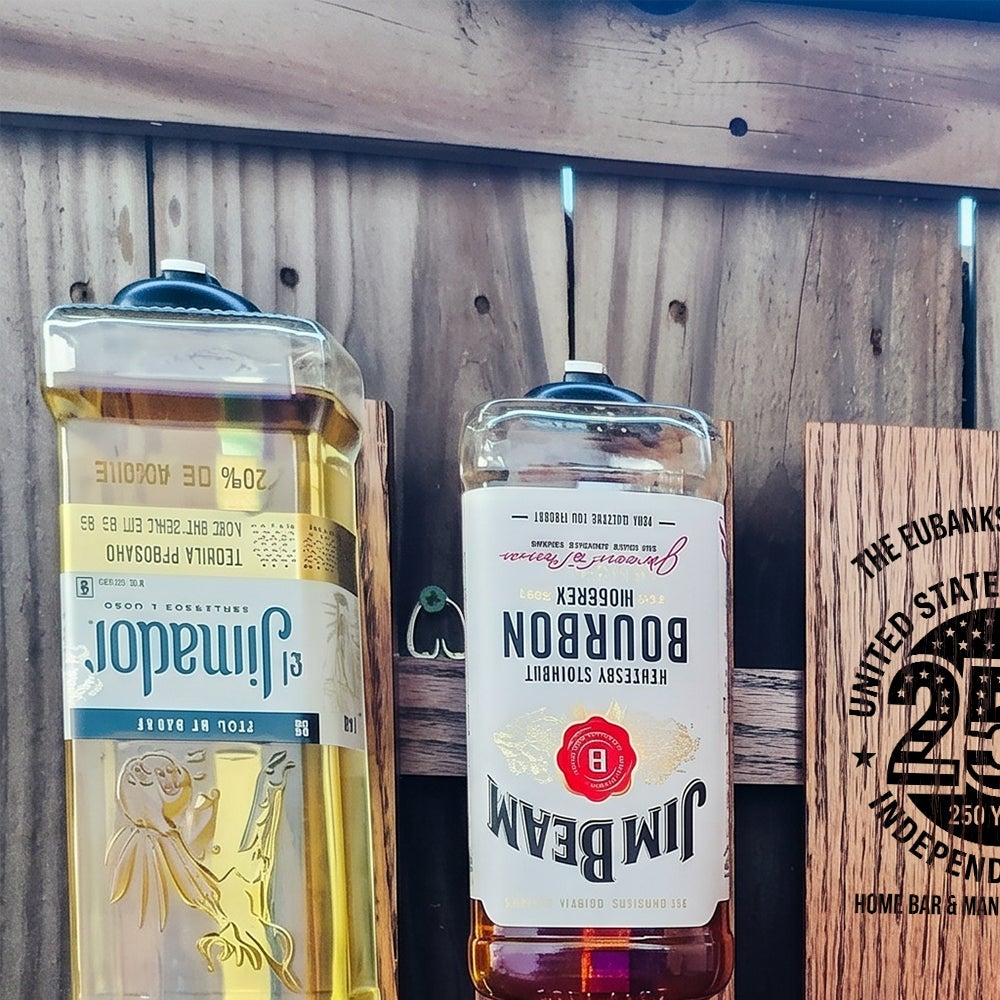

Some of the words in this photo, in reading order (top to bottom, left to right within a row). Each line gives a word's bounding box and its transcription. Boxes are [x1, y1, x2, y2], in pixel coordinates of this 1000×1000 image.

[851, 533, 902, 580] THE
[85, 606, 292, 700] Jimador
[502, 610, 688, 664] BOURBON
[848, 611, 915, 718] UNITED
[588, 747, 607, 773] B
[487, 774, 617, 884] BEAM
[620, 778, 707, 866] JIM
[948, 805, 985, 826] 250
[854, 893, 904, 915] HOME
[908, 894, 943, 916] BAR
[947, 894, 958, 916] &
[964, 895, 1000, 917] MAN
